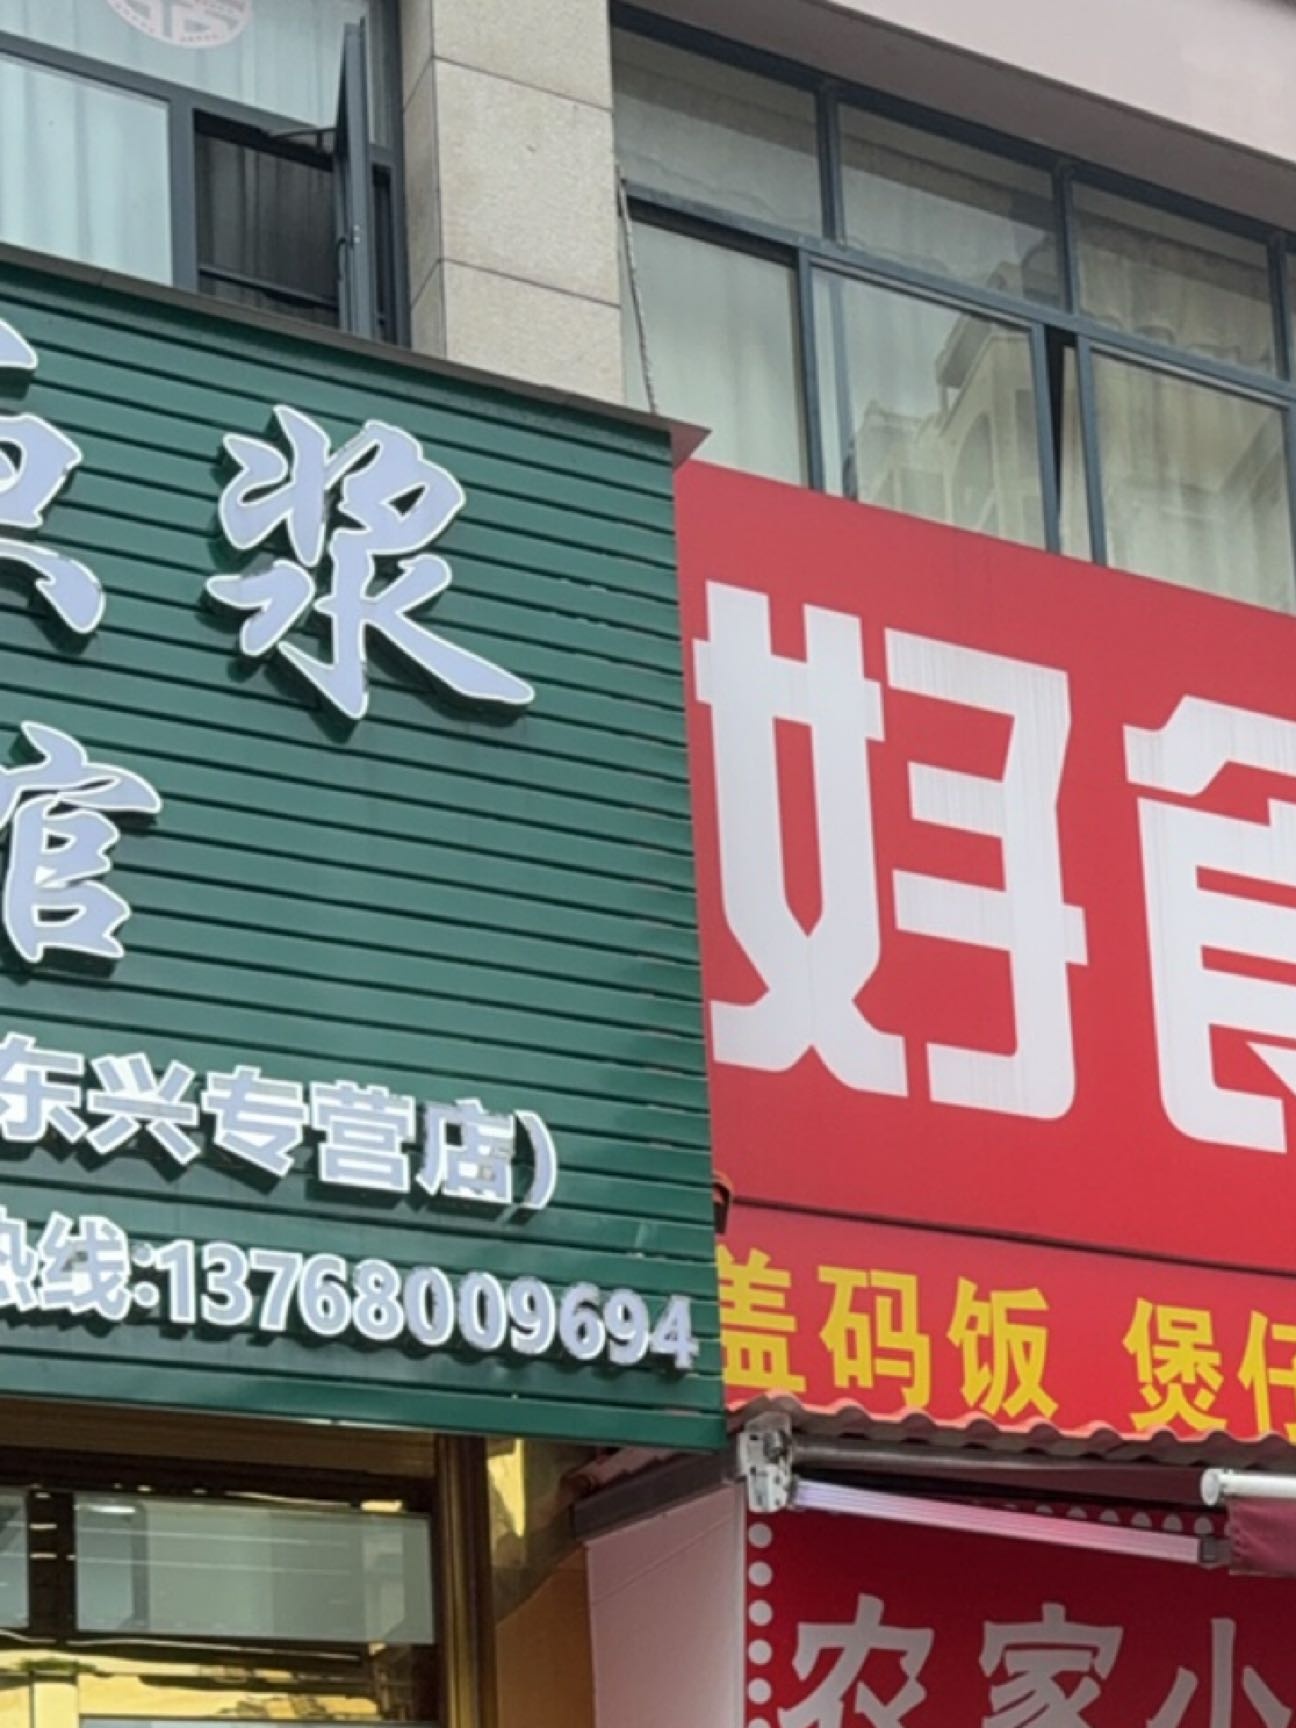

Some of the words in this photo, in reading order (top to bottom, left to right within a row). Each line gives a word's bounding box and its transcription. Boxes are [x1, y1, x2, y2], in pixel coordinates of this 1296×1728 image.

[0, 1031, 558, 1209] 东兴专营店)
[715, 1243, 1059, 1419] 盖码饭
